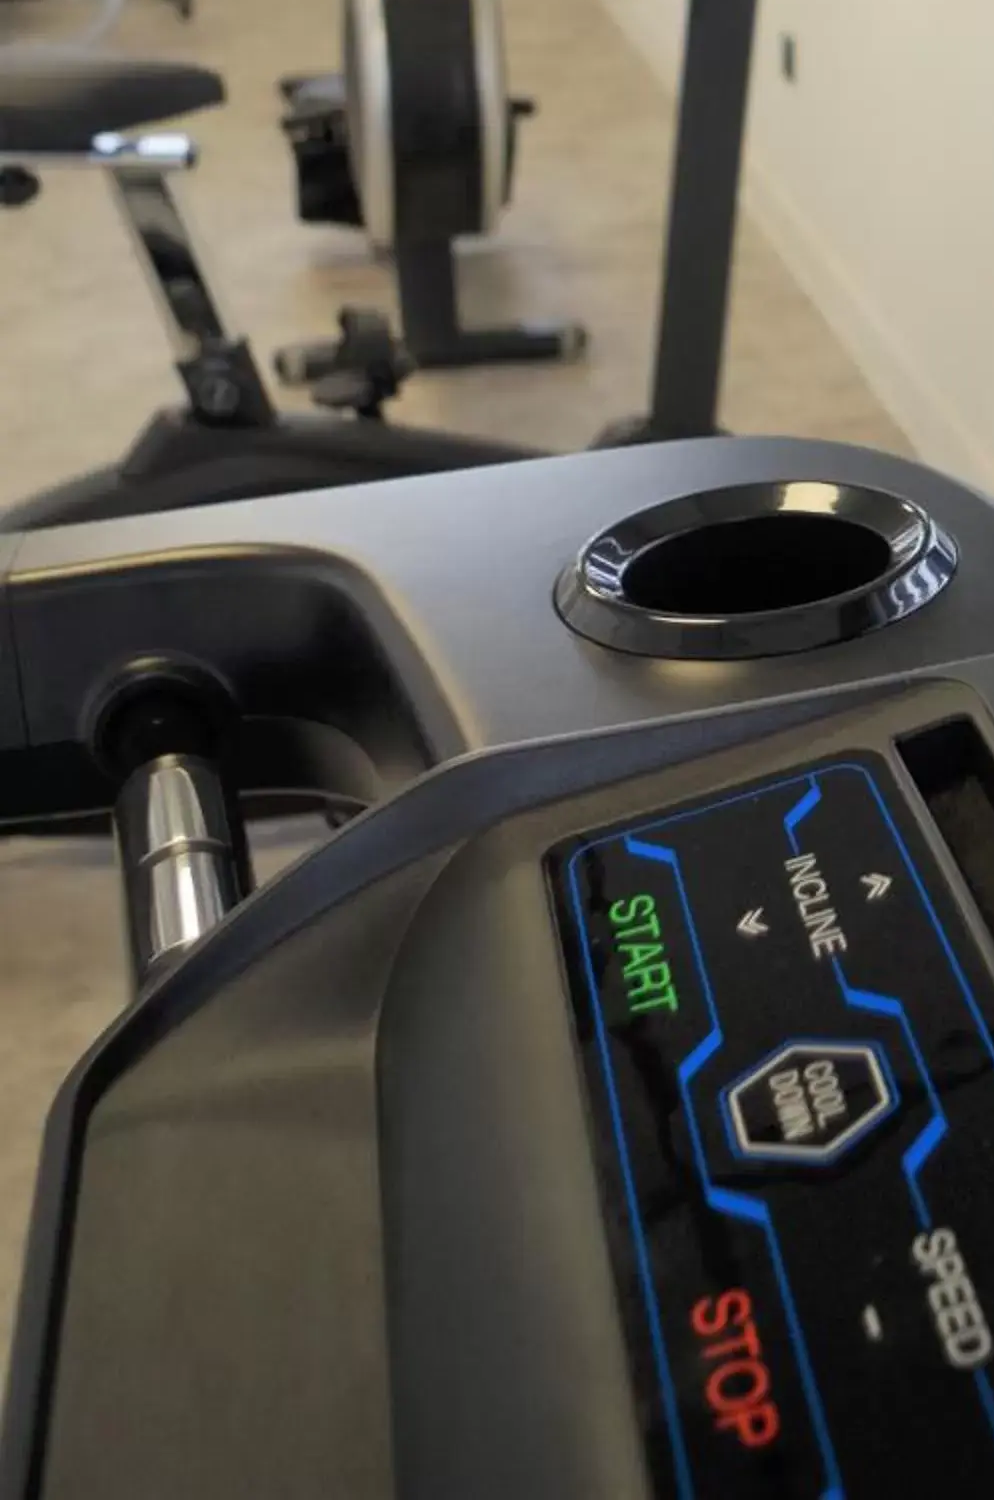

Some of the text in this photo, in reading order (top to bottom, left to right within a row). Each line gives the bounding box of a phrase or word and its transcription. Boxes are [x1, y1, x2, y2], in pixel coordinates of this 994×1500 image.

[608, 893, 678, 1012] START
[784, 852, 848, 959] INCLINE
[769, 1069, 814, 1140] DOWN
[804, 1060, 846, 1129] COOL
[912, 1228, 992, 1366] SPEED
[692, 1289, 778, 1447] STOP
